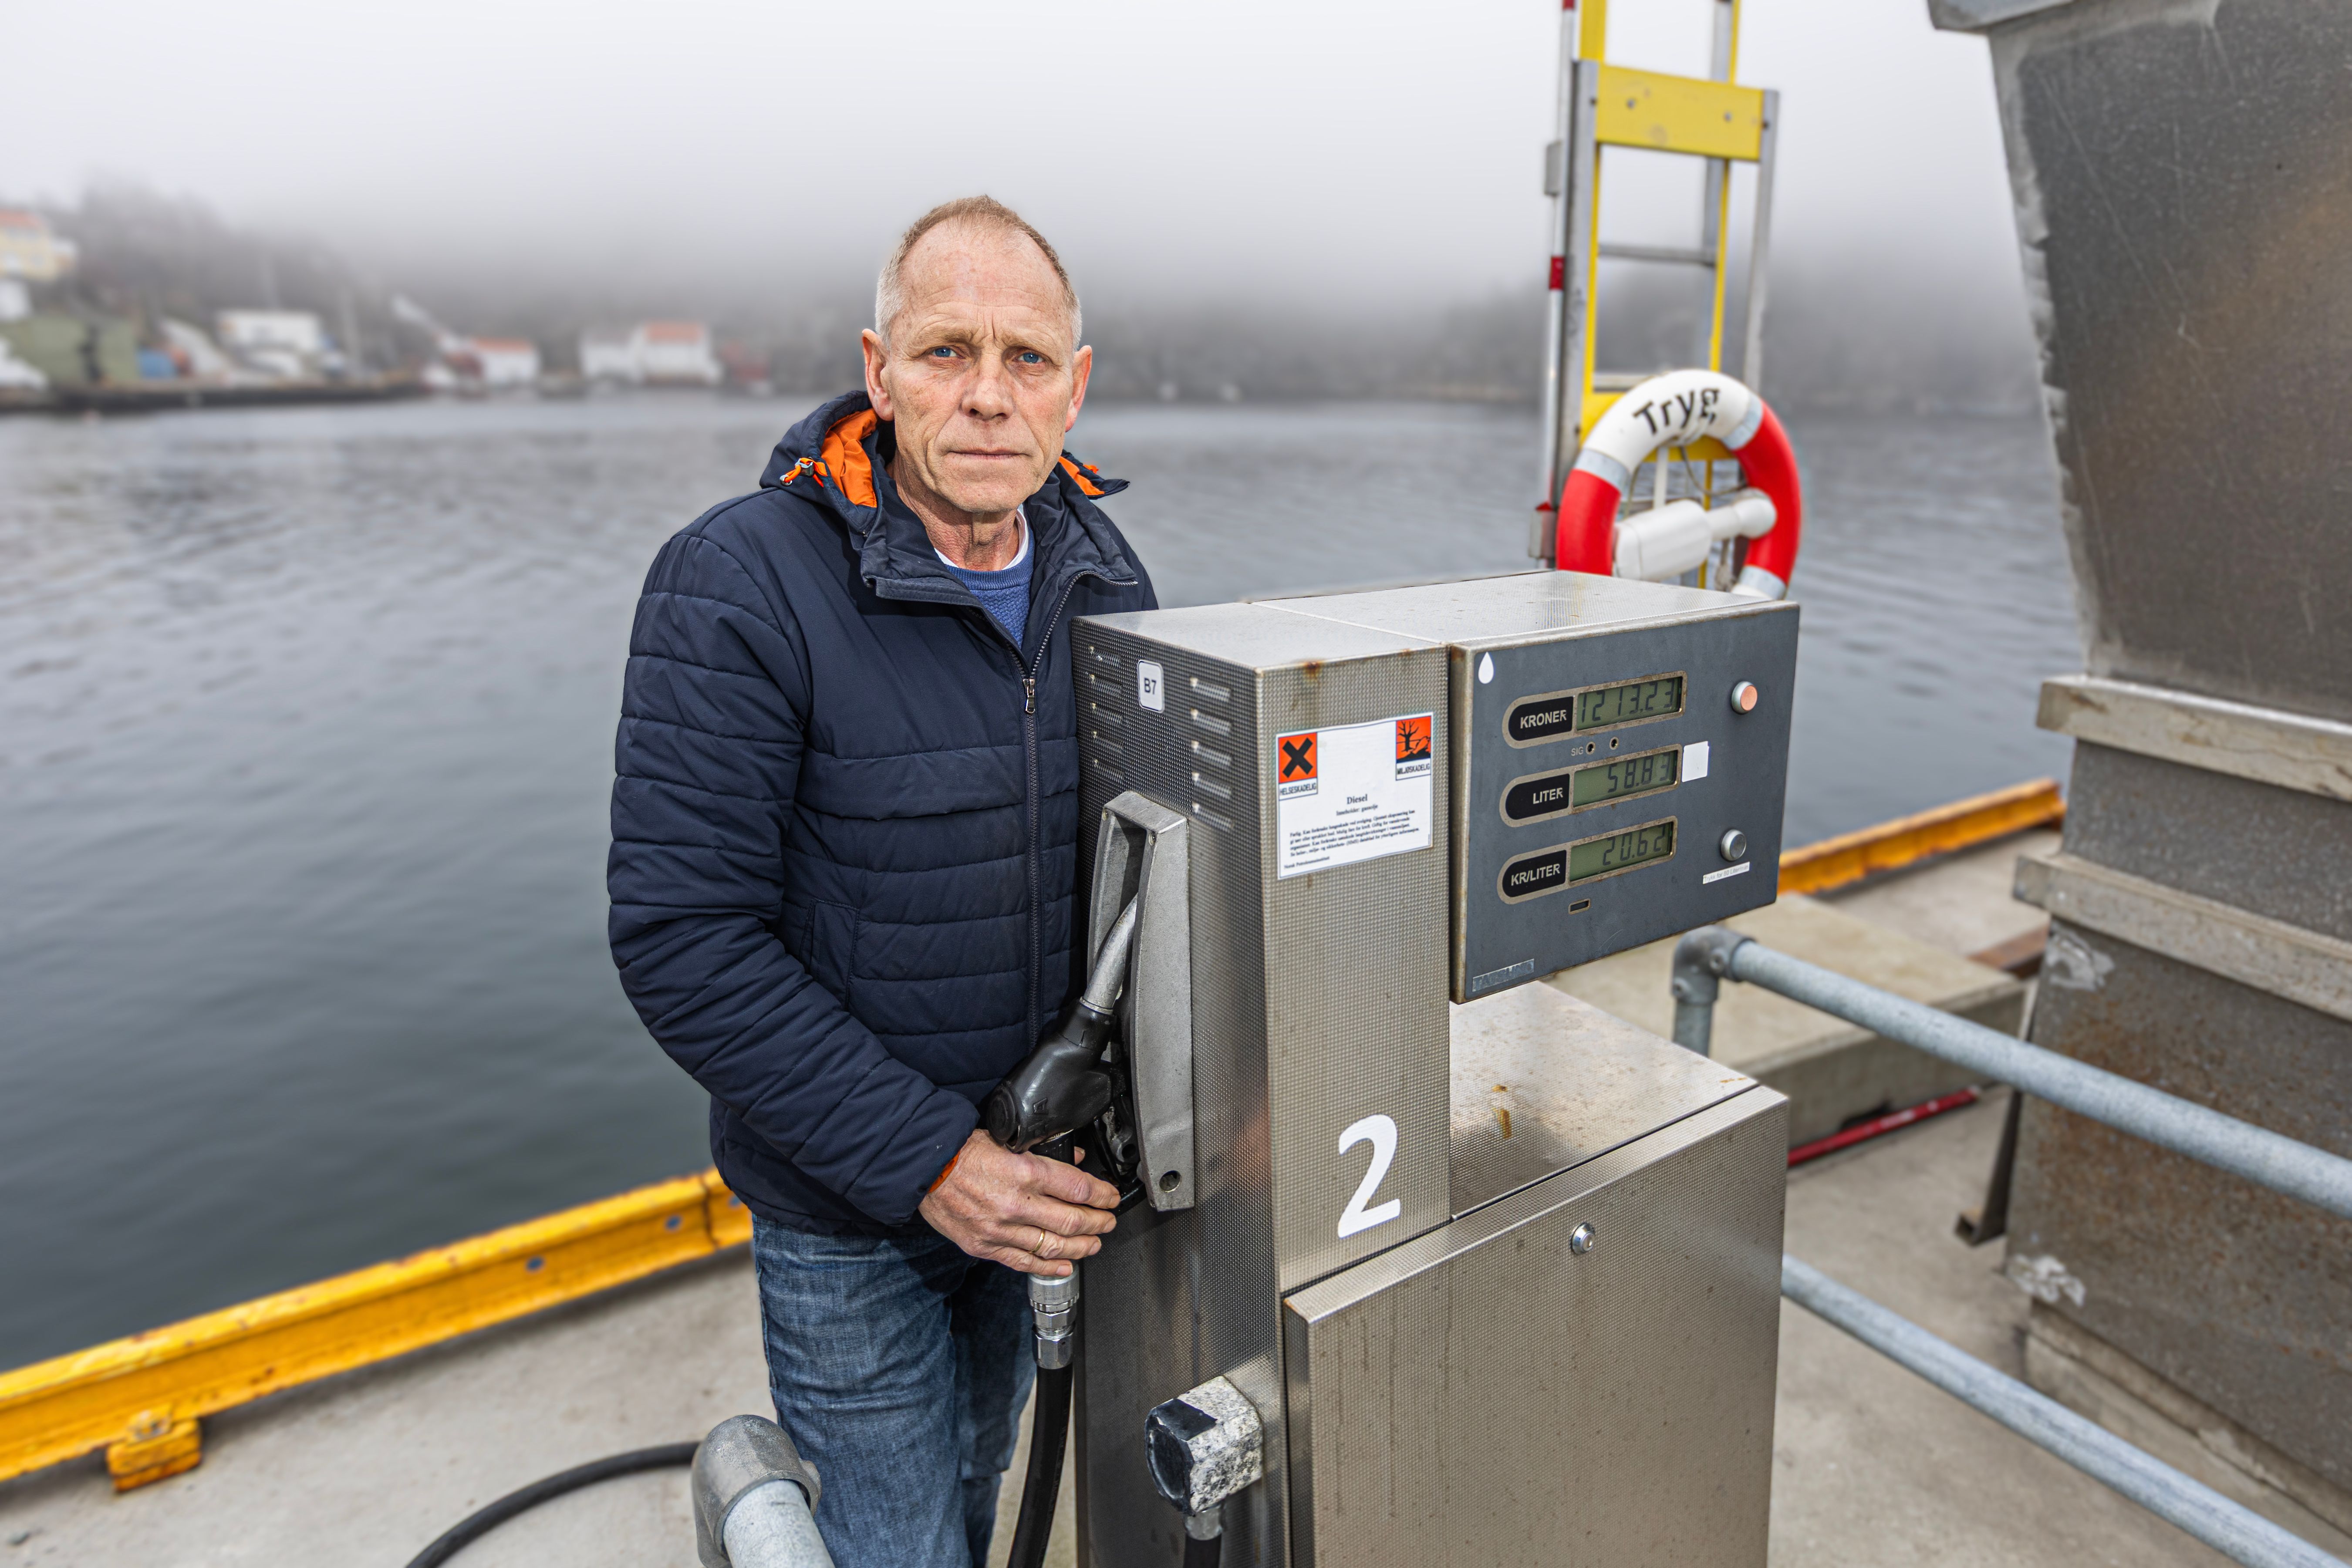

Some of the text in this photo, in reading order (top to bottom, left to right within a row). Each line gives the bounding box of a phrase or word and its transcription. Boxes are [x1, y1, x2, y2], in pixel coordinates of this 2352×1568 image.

[1632, 388, 1720, 435] Tryg
[1144, 678, 1157, 695] B7
[1520, 710, 1567, 729] KRONER
[1571, 747, 1584, 756] SIG
[1608, 752, 1670, 793] 58.83
[1280, 782, 1317, 796] HELSESKADELIG
[1532, 787, 1564, 804] LITER
[1347, 794, 1367, 804] Diesel
[1603, 823, 1665, 866] 20.62
[1511, 863, 1560, 886] KR/LITER
[1337, 1114, 1401, 1239] 2
